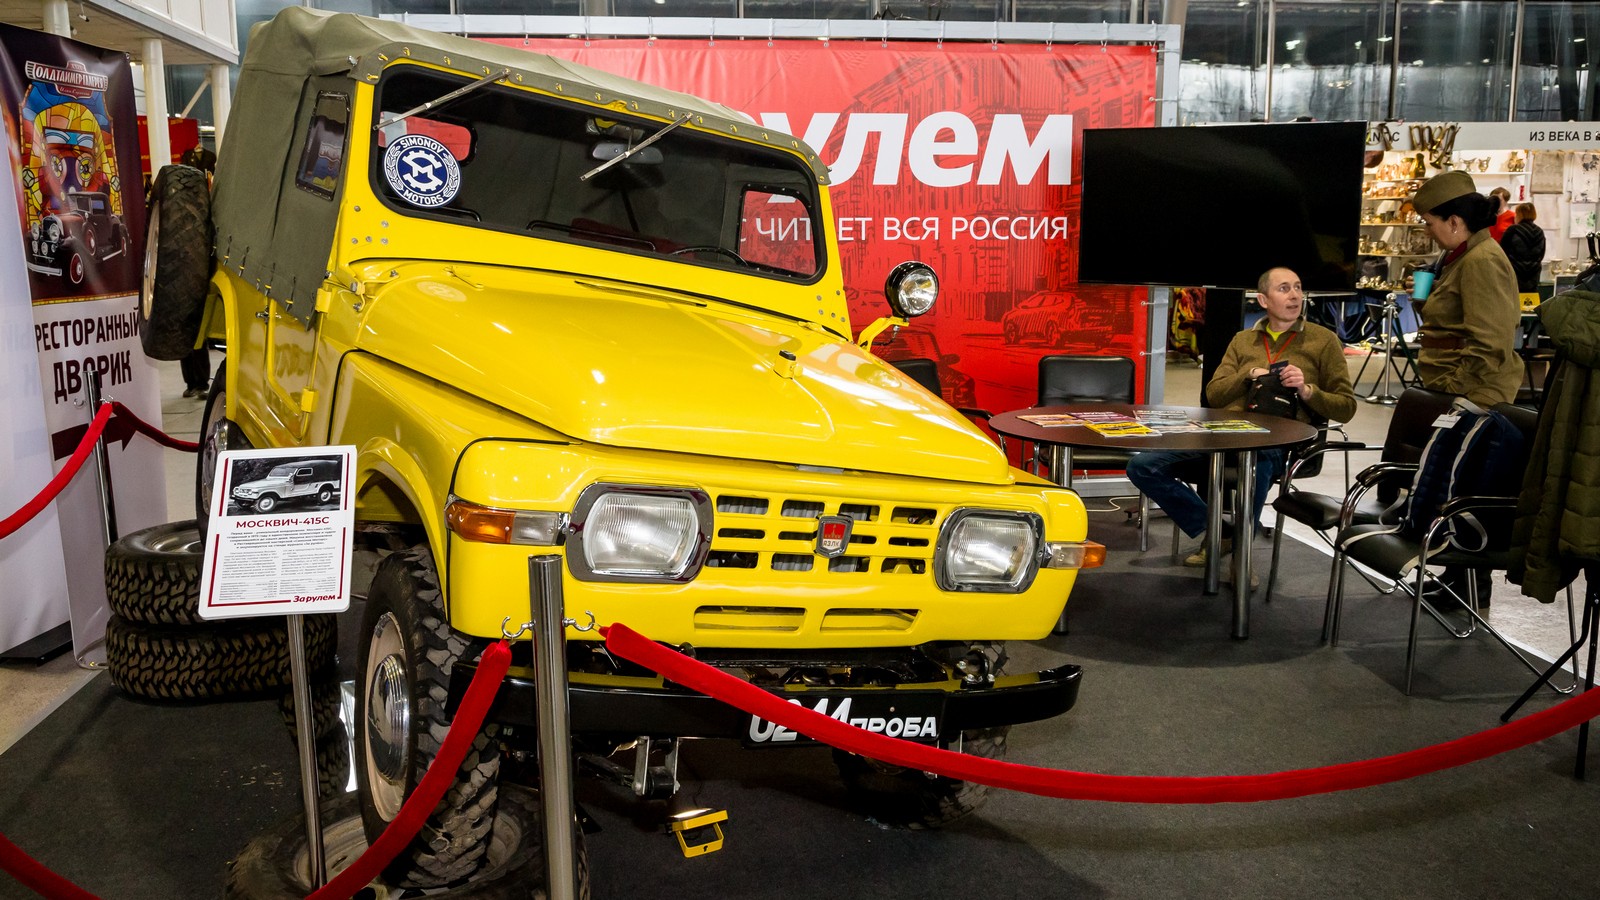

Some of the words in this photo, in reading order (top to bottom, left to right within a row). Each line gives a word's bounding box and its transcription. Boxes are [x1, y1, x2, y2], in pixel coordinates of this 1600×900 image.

[1529, 131, 1545, 141] ИЗ
[1548, 131, 1580, 141] ВЕКА
[1583, 131, 1592, 141] В
[400, 137, 444, 153] SIMONOV
[402, 189, 444, 205] MOTORS
[756, 217, 872, 242] ЧИТЕТ
[883, 217, 940, 241] ВСЯ
[951, 216, 1068, 241] РОССИЯ
[236, 516, 330, 529] МОСКВИЧ-415С
[850, 716, 937, 738] ПРОБА
